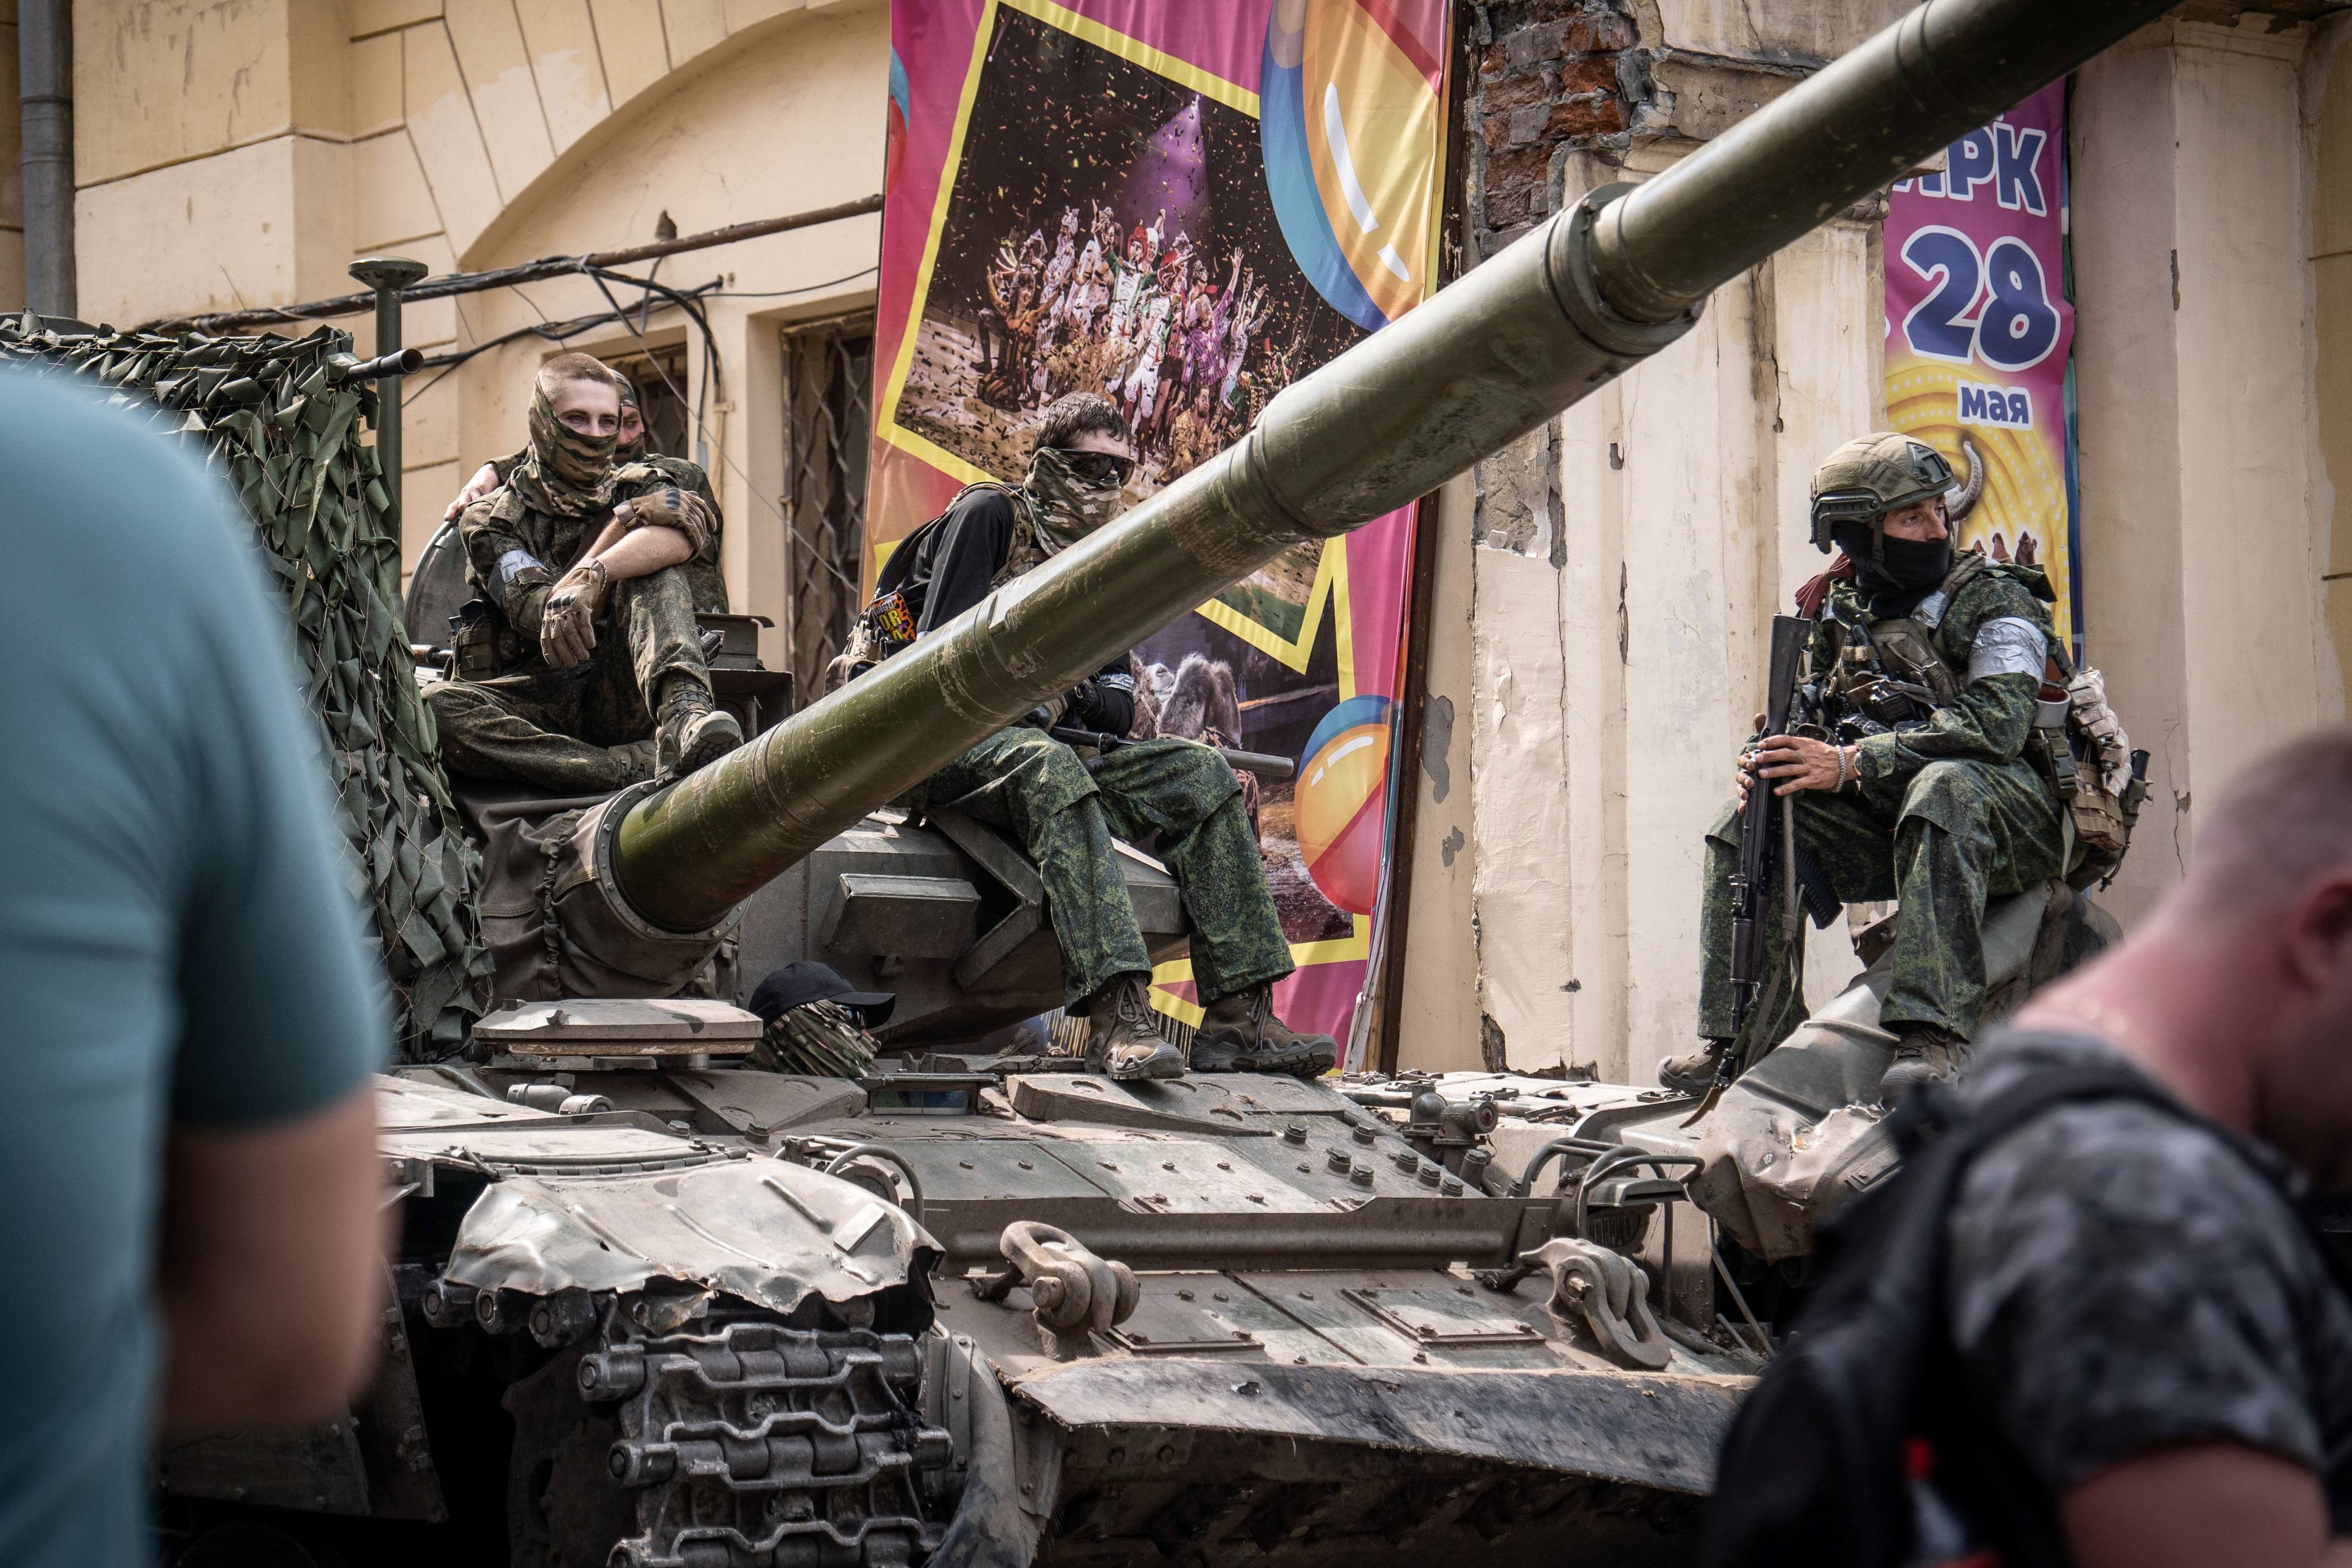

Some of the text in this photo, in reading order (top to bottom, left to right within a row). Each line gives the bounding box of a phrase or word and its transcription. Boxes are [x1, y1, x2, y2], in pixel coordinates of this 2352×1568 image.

[1893, 121, 2047, 217] РК
[1902, 226, 2060, 370] 28
[1959, 381, 2032, 428] мая
[879, 609, 902, 631] OR
